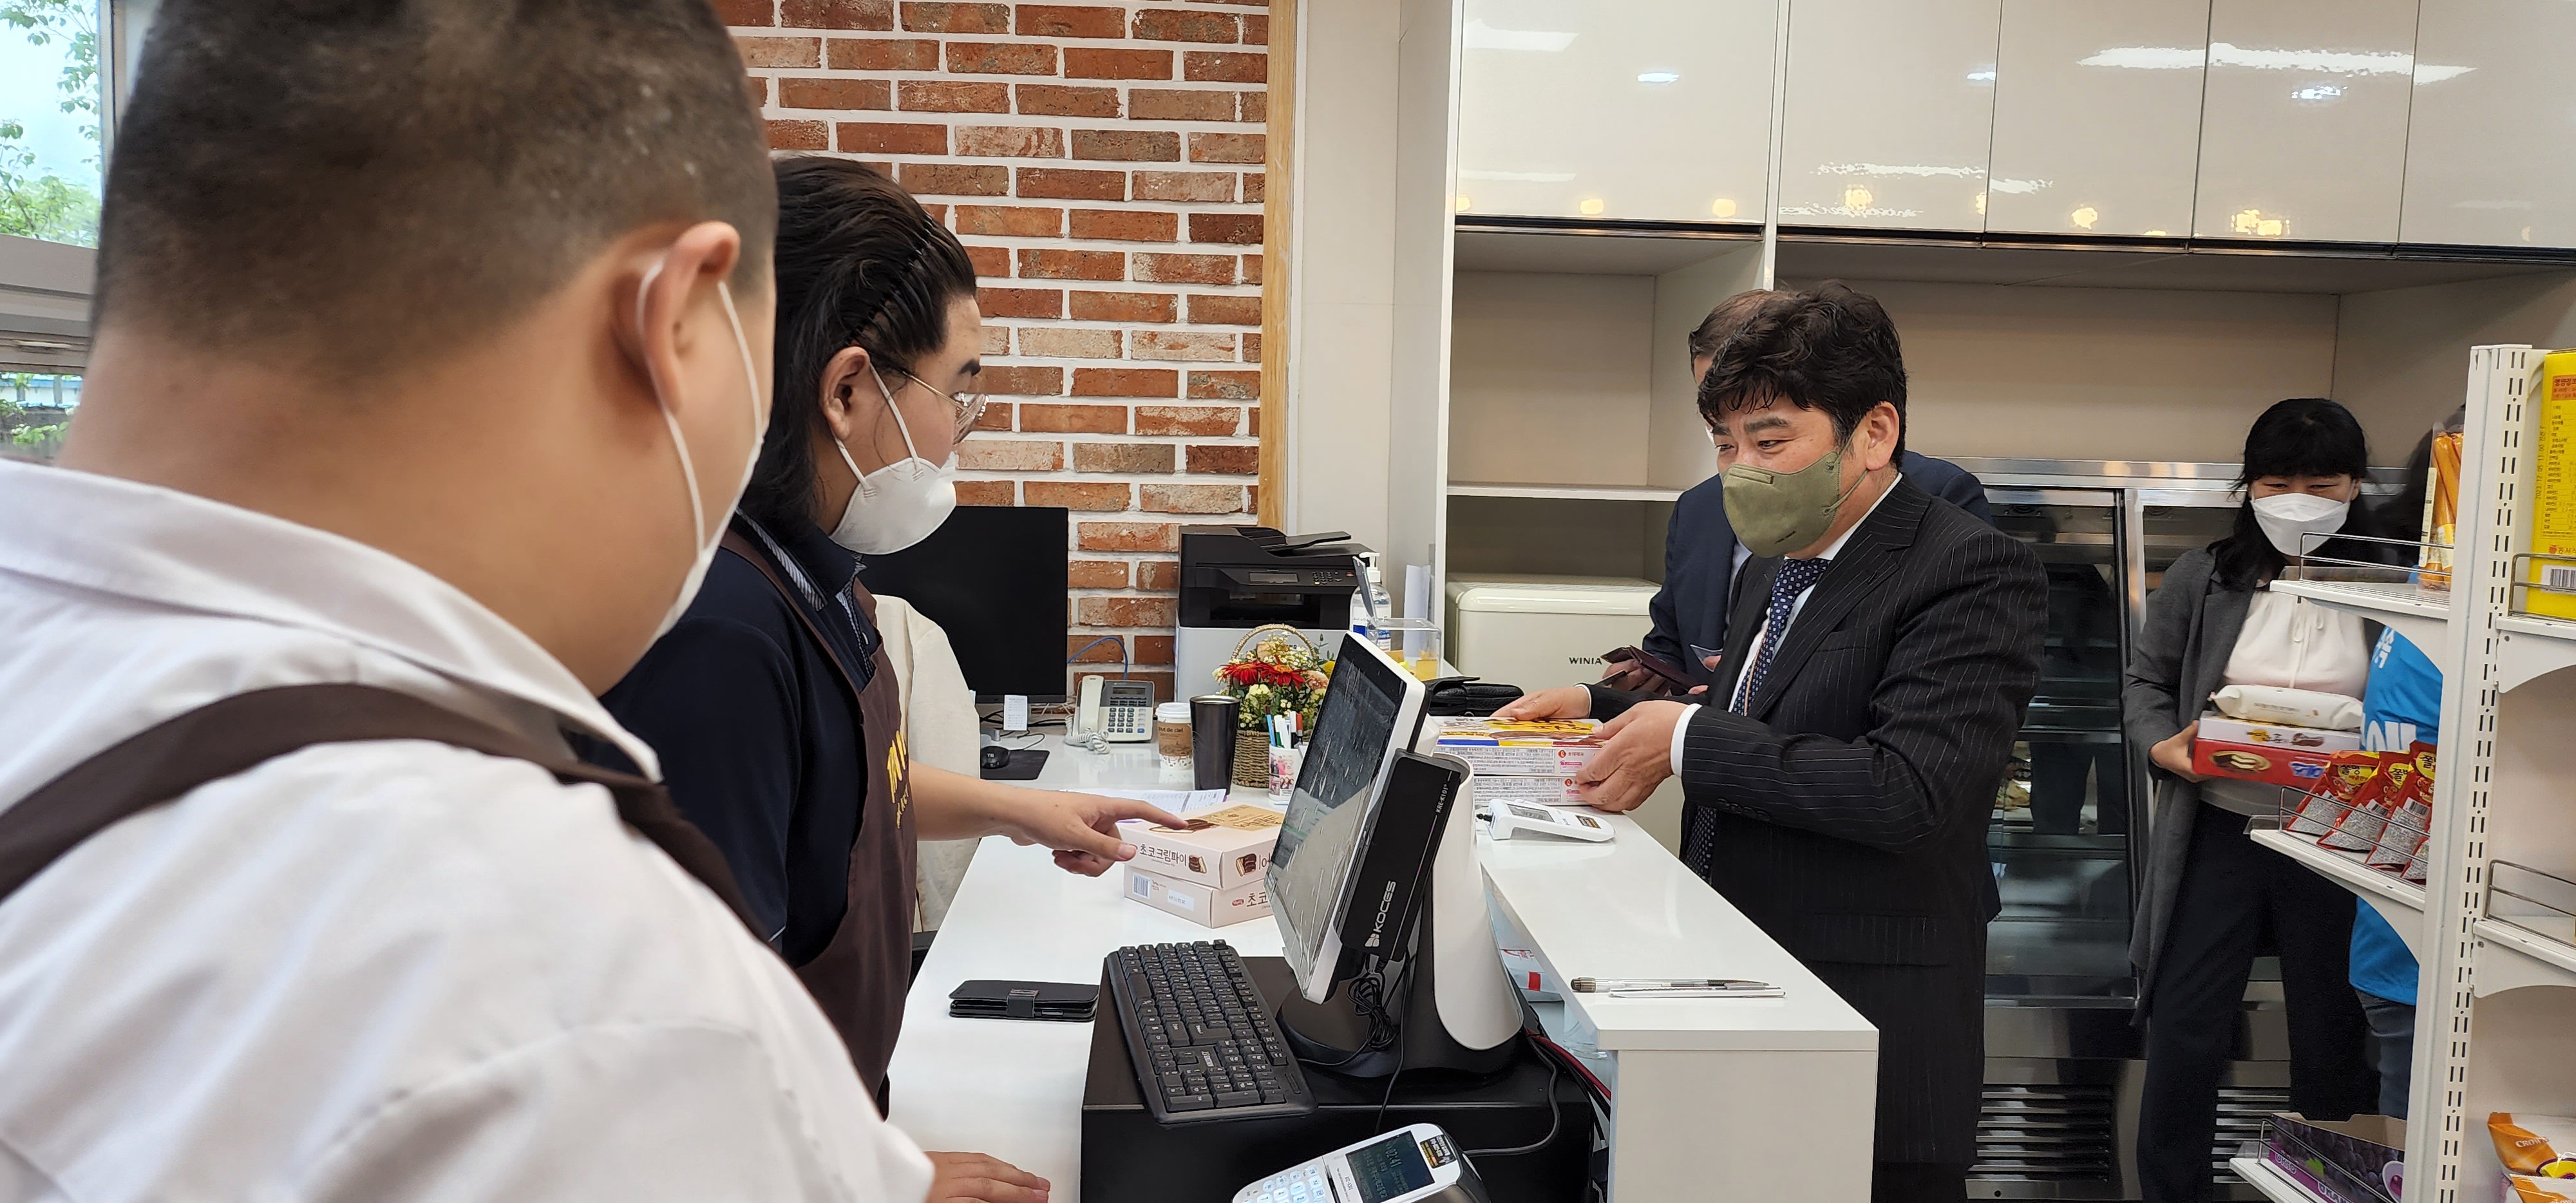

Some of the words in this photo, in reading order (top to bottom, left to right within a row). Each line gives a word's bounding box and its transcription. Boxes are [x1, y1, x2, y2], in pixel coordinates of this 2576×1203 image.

[1139, 844, 1187, 867] 초코크림파이
[1374, 880, 1396, 934] KOCES
[1386, 1147, 1402, 1168] 02:41
